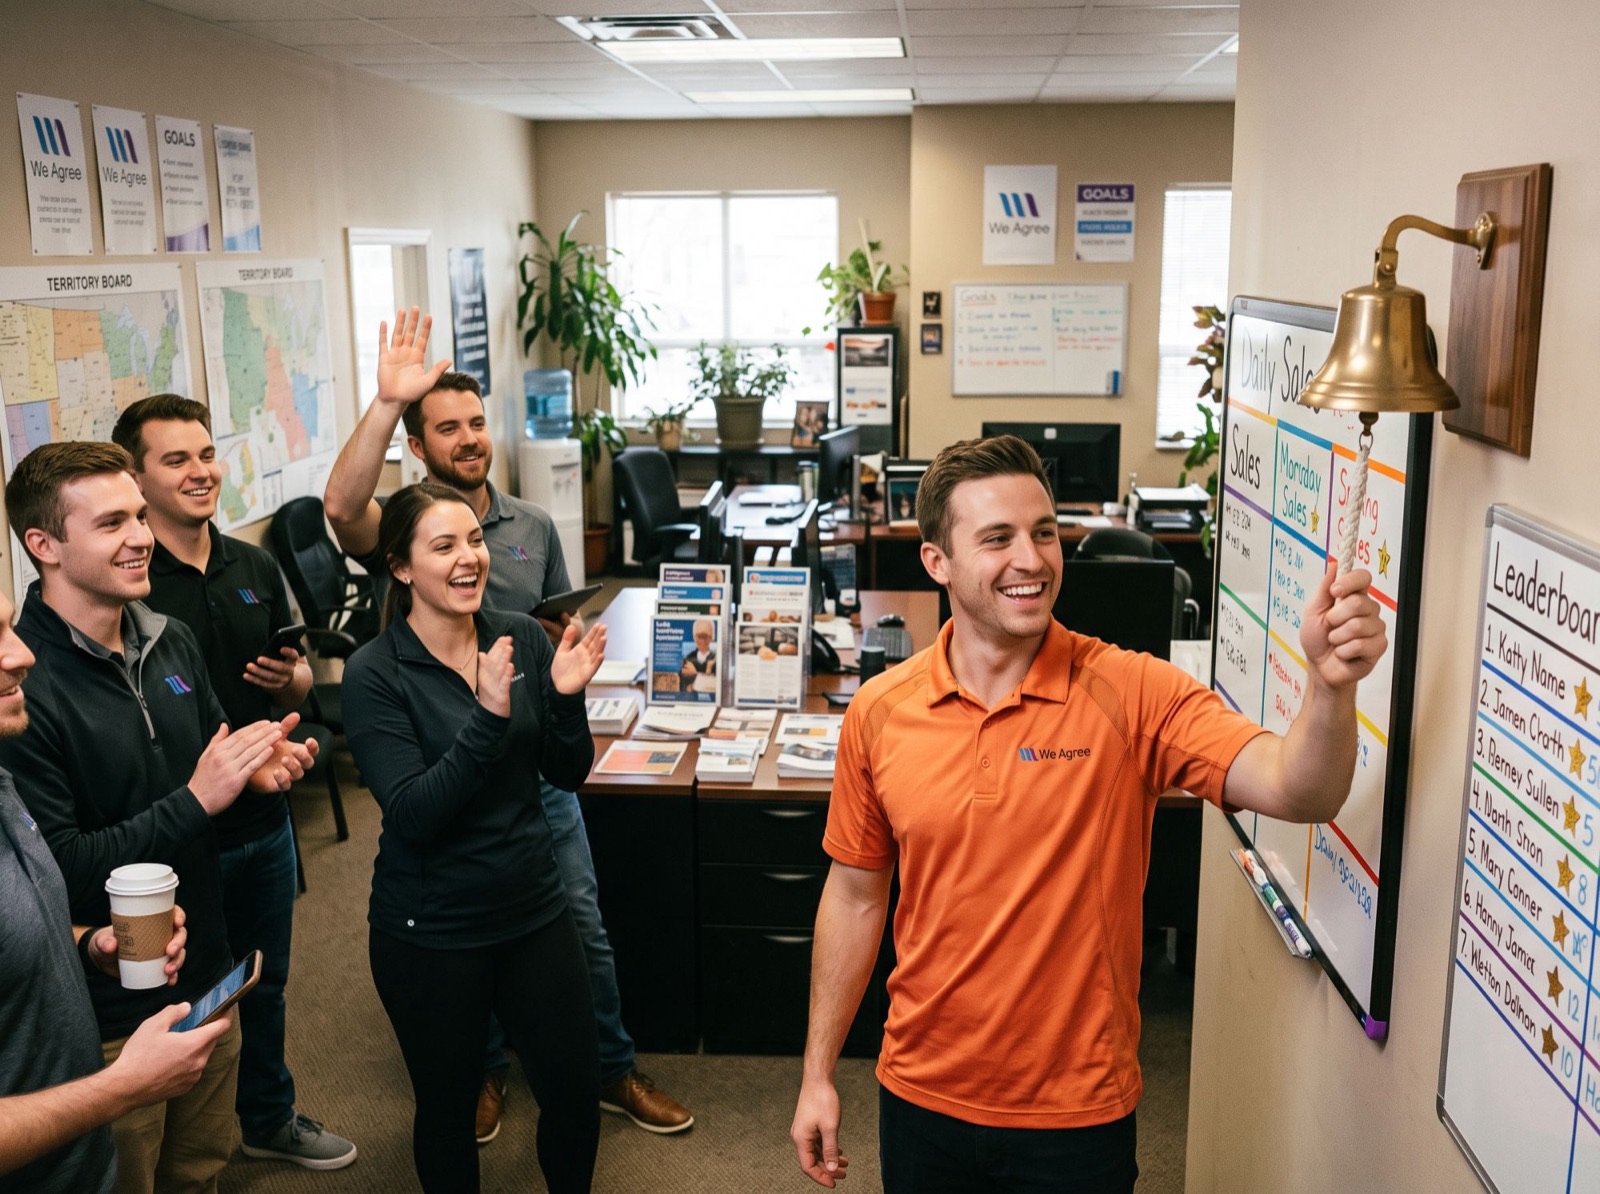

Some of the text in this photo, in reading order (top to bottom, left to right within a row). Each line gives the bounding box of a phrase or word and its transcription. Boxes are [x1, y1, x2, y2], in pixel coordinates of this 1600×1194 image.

[164, 129, 196, 147] GOALS
[30, 160, 82, 183] We Agree
[102, 166, 119, 183] We
[120, 168, 147, 188] Agree
[1082, 188, 1129, 200] GOALS
[989, 222, 1050, 237] We Agree
[47, 274, 132, 291] TERRITORY BOARD
[238, 267, 293, 281] TERRITORY BOARD
[1241, 326, 1276, 415] Daily
[1231, 423, 1260, 490] Sales
[1282, 485, 1307, 527] Sales
[1338, 467, 1378, 535] Sing
[1485, 624, 1494, 654] 1.
[1531, 650, 1566, 700] Name
[1479, 679, 1489, 707] 2.
[1039, 747, 1091, 761] We Agree
[1476, 728, 1485, 759] 3.
[1526, 769, 1559, 819] Sullen
[1582, 813, 1594, 847] 5
[1472, 779, 1481, 811] 4.
[1578, 873, 1588, 906] 8
[1467, 827, 1543, 921] 5. Mary Conner
[1464, 879, 1472, 909] 6.
[1475, 891, 1503, 947] Hanny
[1567, 989, 1580, 1022] 12
[1460, 928, 1467, 958] 7.
[1561, 1045, 1574, 1078] 10
